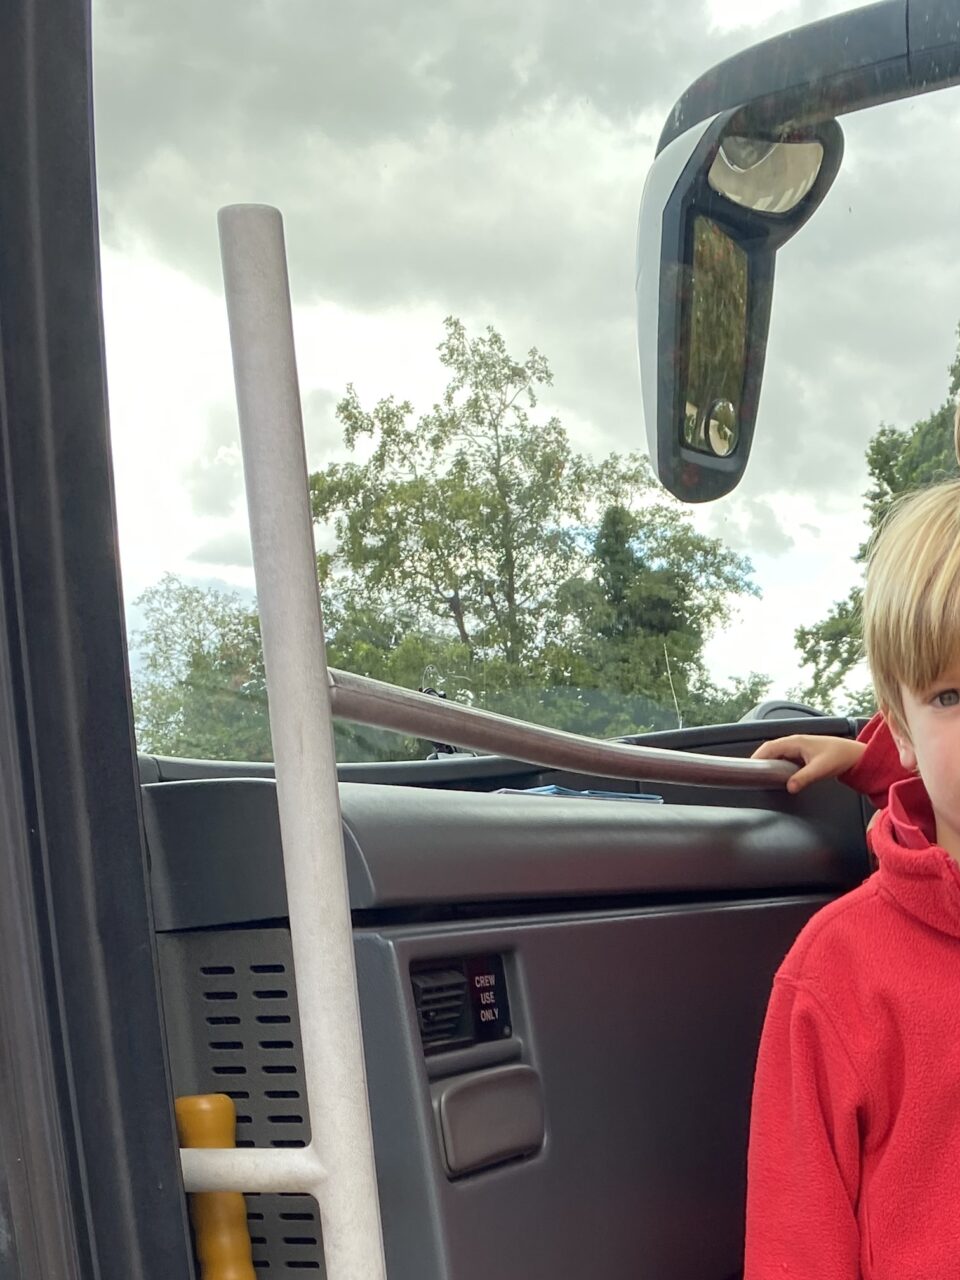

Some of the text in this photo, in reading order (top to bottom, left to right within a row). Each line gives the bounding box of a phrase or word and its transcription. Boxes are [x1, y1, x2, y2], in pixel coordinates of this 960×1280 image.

[475, 975, 495, 987] CREW
[481, 992, 495, 1004] USE
[480, 1009, 498, 1022] ONLY
